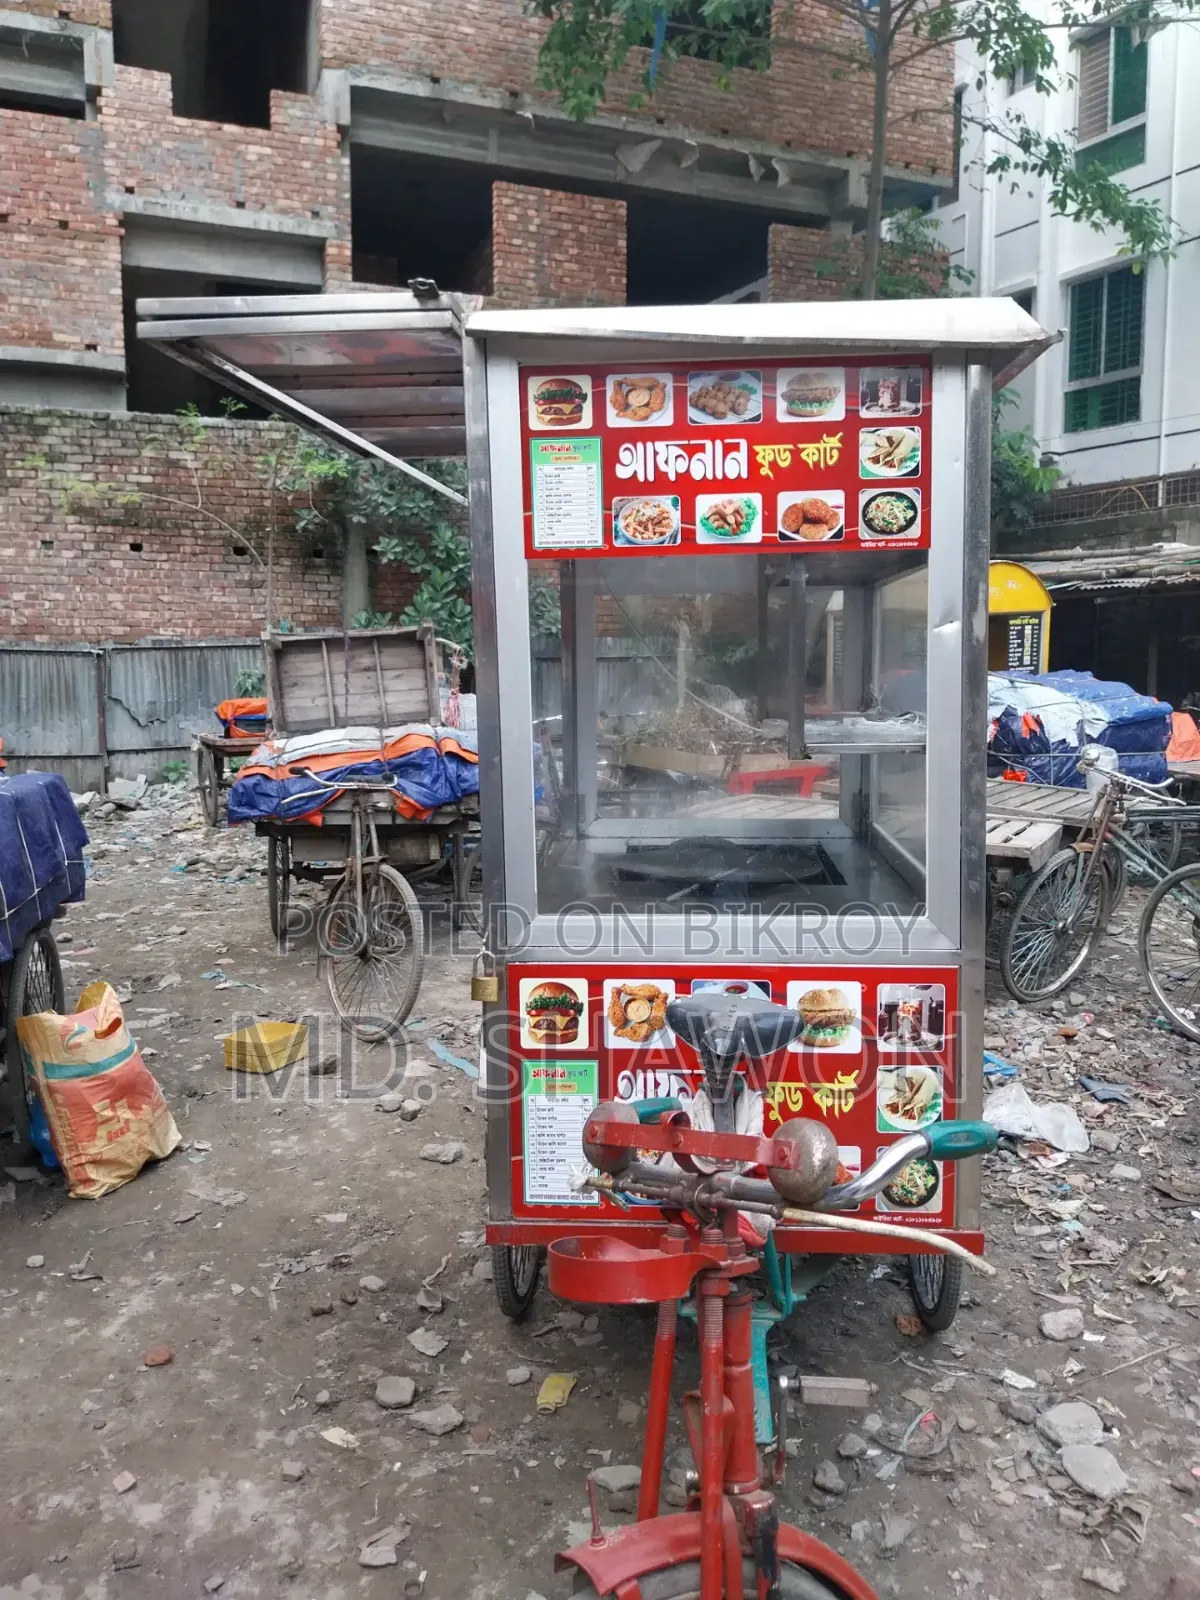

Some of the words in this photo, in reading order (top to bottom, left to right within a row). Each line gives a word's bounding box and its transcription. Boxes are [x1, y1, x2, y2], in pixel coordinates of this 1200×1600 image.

[615, 438, 748, 483] আফনান
[753, 444, 793, 480] ফুড
[798, 432, 843, 470] কার্ট
[532, 1068, 567, 1080] আফনান
[766, 1082, 806, 1125] ফুড
[806, 1069, 860, 1119] কার্ট
